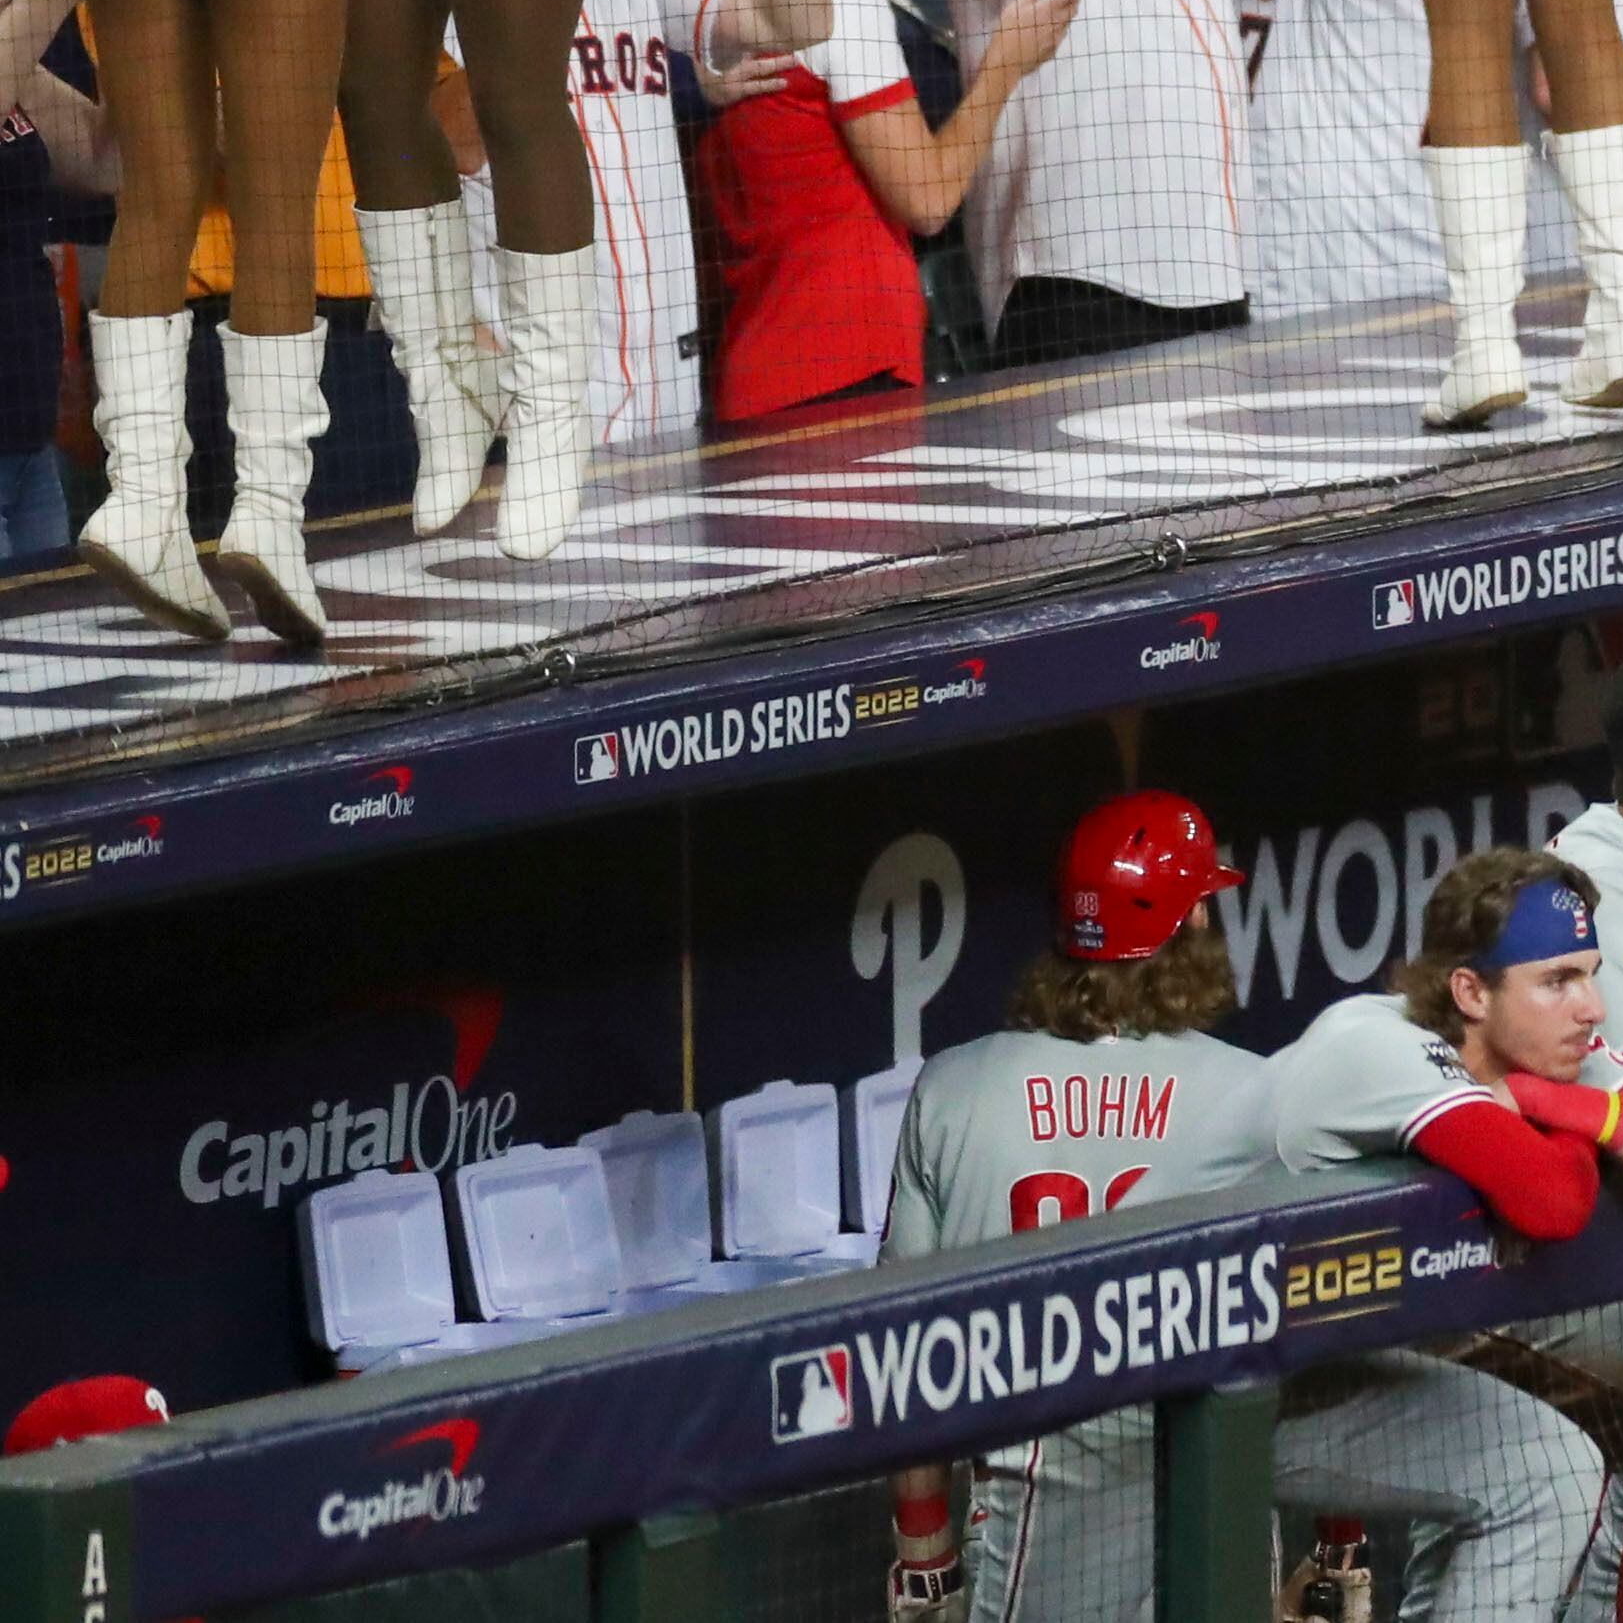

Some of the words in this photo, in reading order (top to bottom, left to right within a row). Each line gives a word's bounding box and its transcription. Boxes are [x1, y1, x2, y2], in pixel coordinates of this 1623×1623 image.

[1416, 554, 1532, 623] WORLD
[621, 707, 744, 777] WORLD
[749, 683, 851, 754] SERIES
[854, 684, 920, 720] 2022
[25, 844, 93, 880] 2022
[1024, 1073, 1177, 1143] BOHM
[854, 1291, 1082, 1429] WORLD
[1092, 1242, 1280, 1378] SERIES
[1285, 1246, 1402, 1309] 2022
